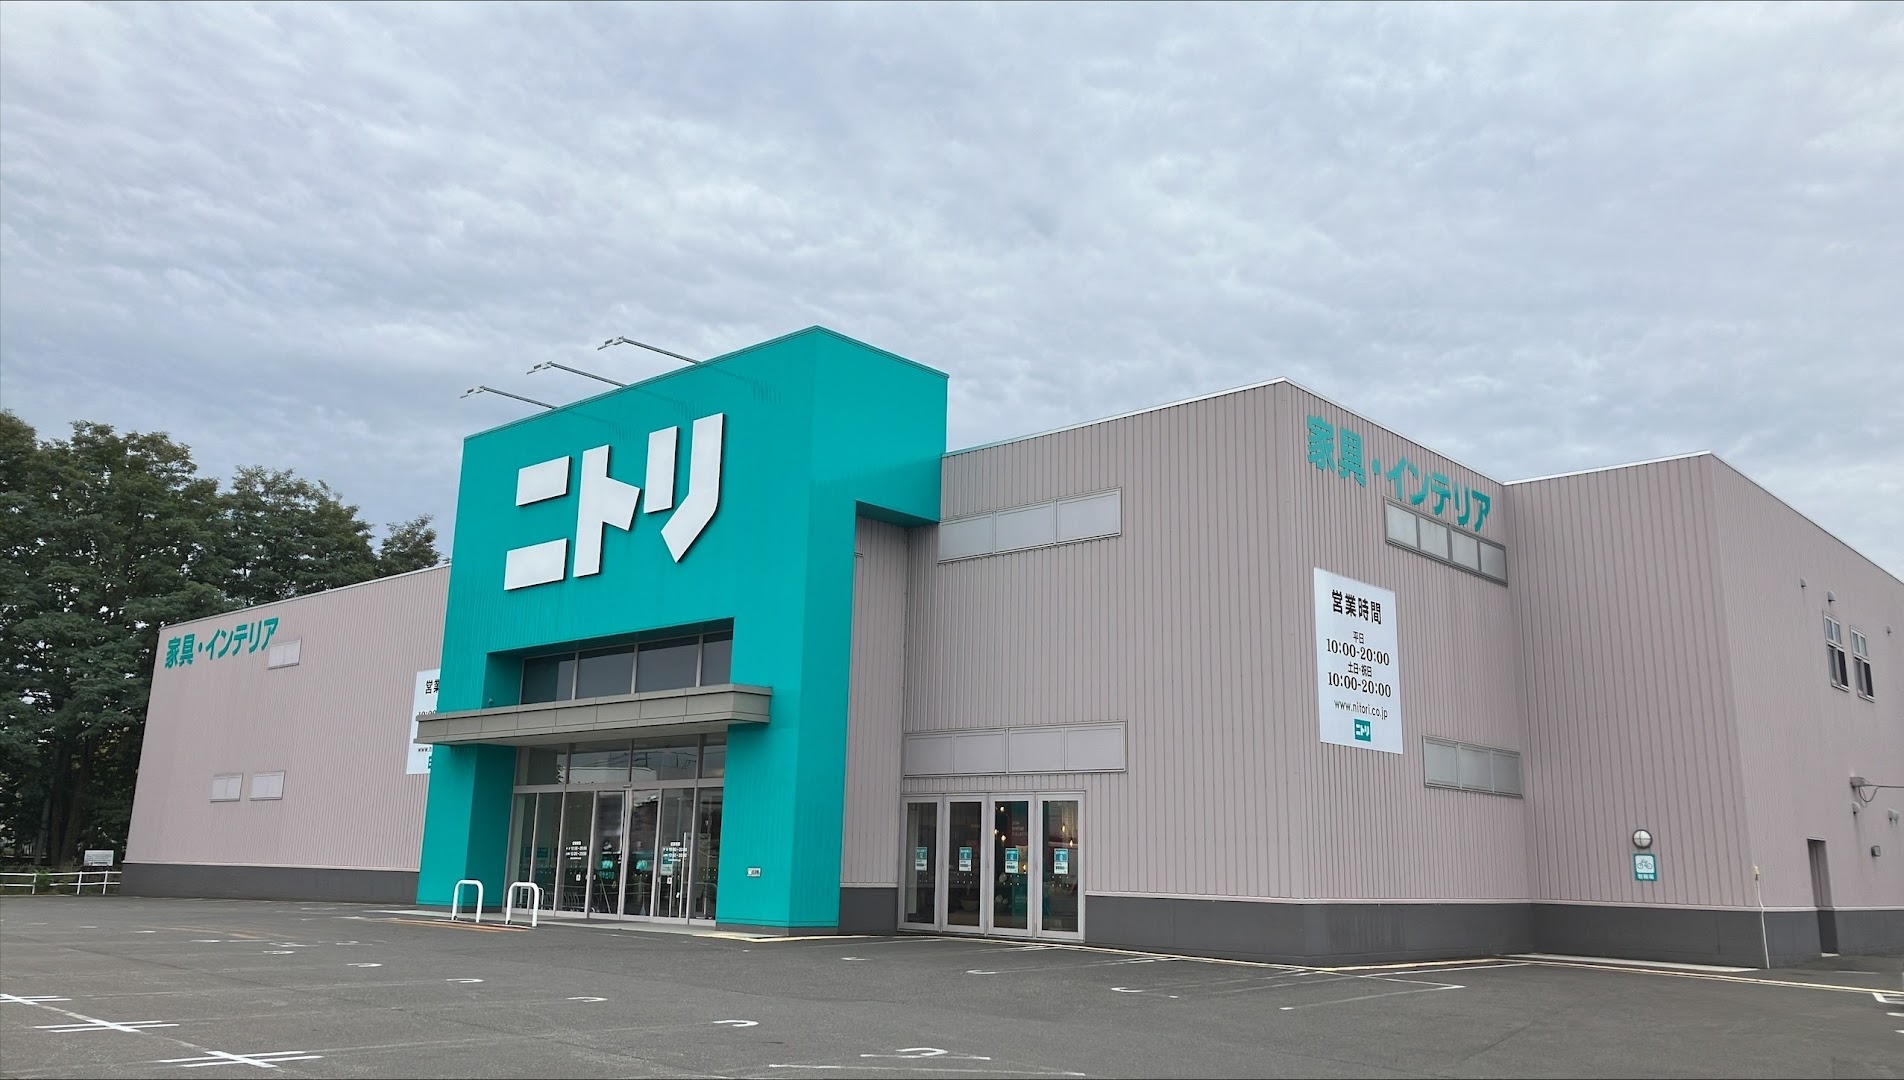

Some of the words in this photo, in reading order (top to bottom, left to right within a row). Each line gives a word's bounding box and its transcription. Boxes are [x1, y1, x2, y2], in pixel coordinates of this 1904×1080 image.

[1307, 415, 1491, 532] 家具・インテリア
[504, 413, 724, 591] ニトリ
[1331, 589, 1382, 625] 営業時間
[165, 617, 279, 669] 家具・インテリア
[1352, 631, 1365, 644] 平日
[1326, 638, 1390, 666] 10:00-20:00
[1327, 671, 1392, 698] 10:00-20:00
[1333, 700, 1388, 720] www.nitori.co.jp
[1355, 723, 1370, 738] ニトリ
